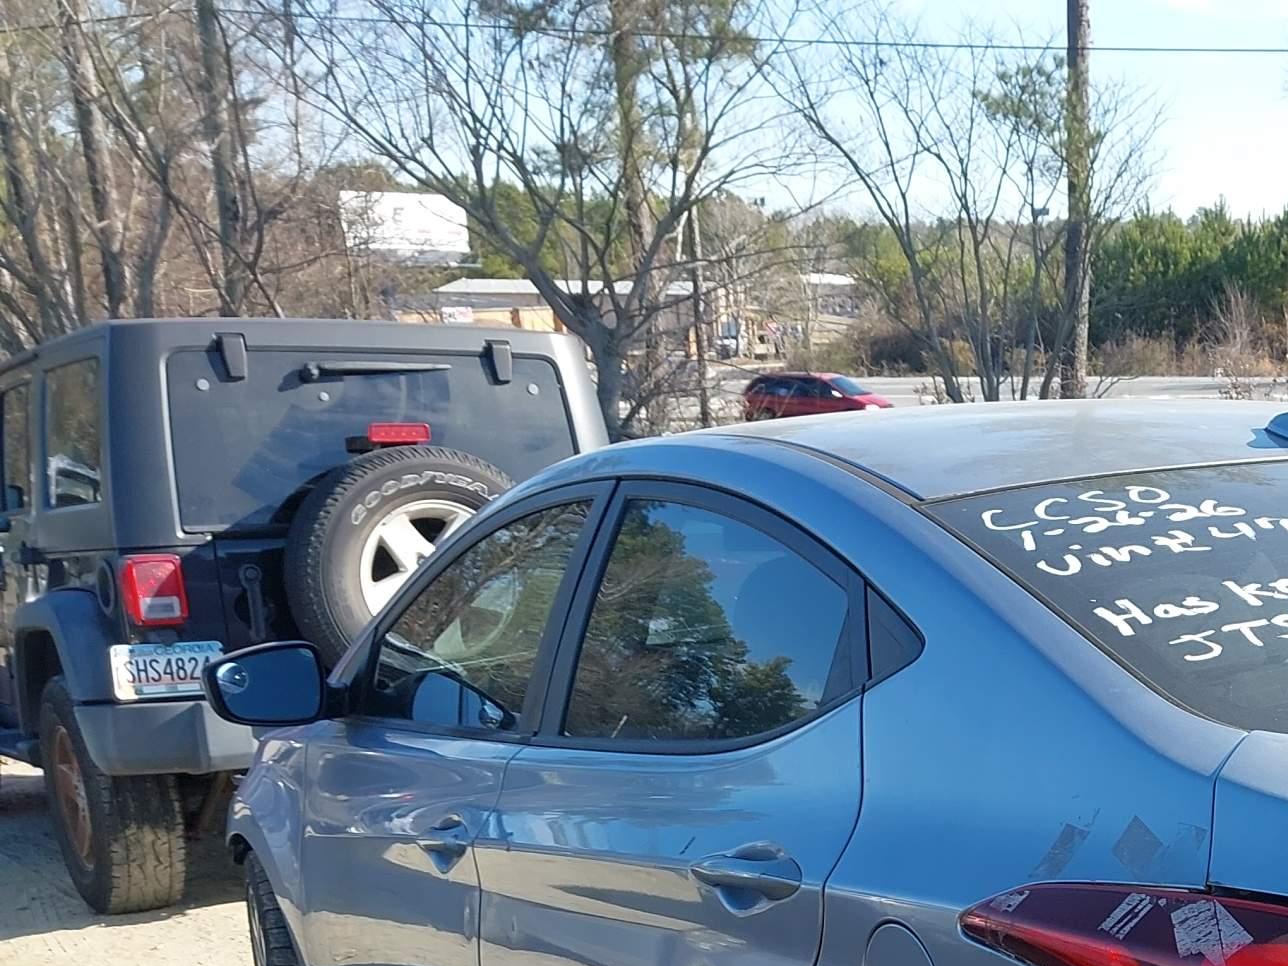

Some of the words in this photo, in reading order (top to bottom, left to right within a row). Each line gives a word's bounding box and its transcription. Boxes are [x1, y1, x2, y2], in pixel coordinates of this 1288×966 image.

[1093, 596, 1220, 637] Has
[153, 643, 216, 656] GEORGIA
[124, 656, 209, 684] SHS482
